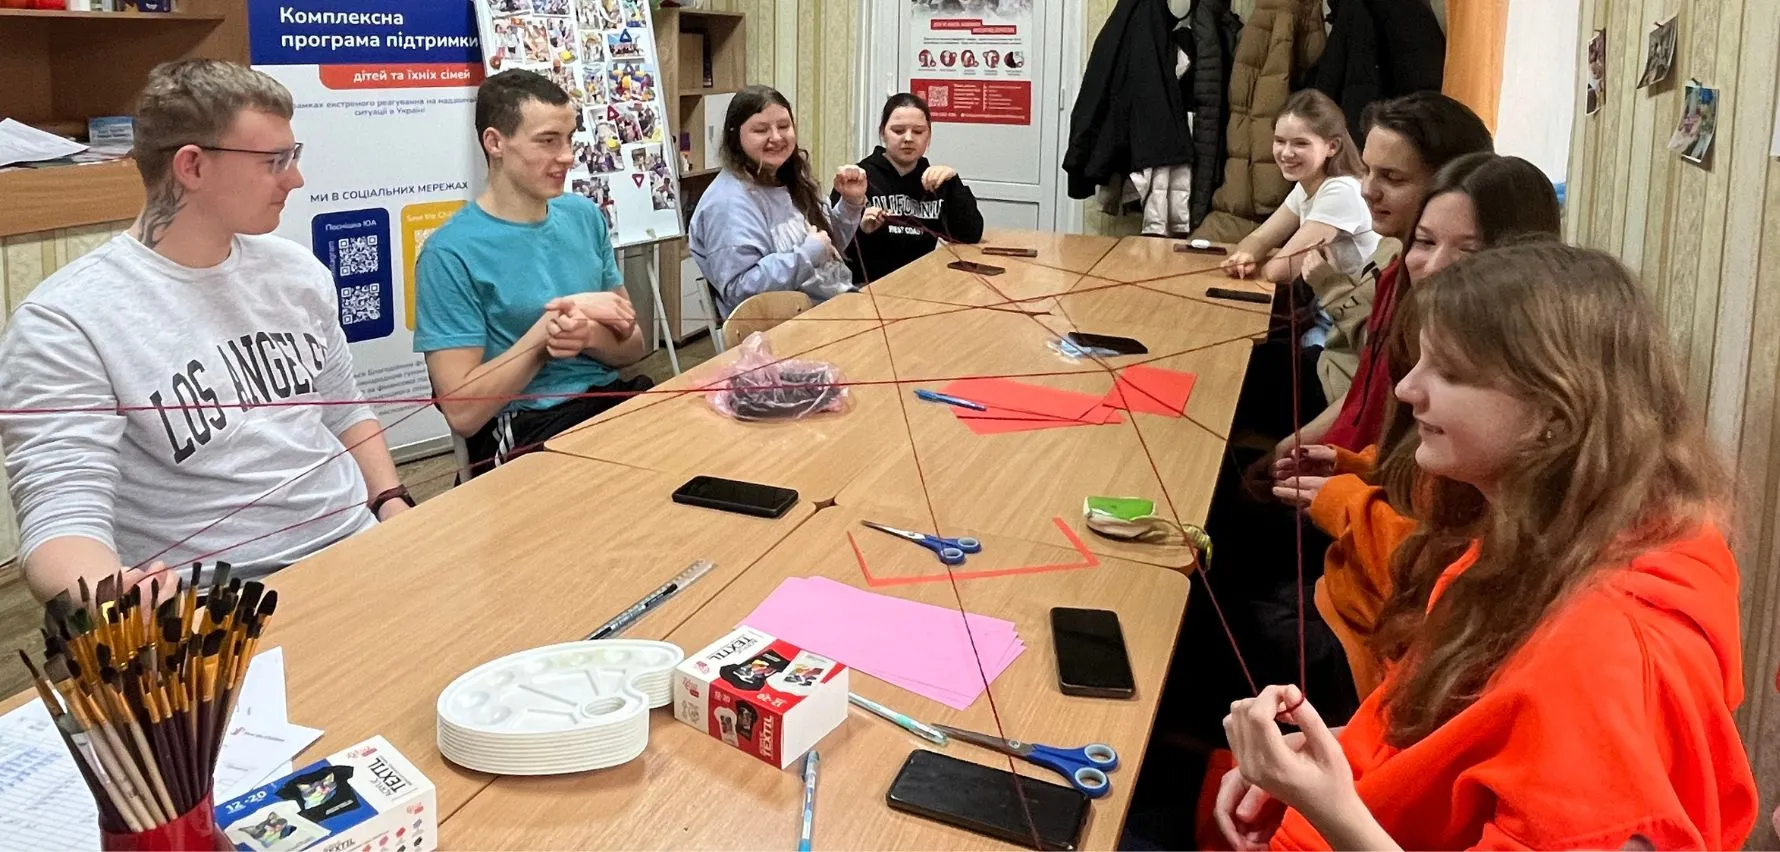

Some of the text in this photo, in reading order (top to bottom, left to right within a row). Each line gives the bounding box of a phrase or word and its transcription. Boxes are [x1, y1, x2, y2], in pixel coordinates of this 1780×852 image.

[280, 6, 404, 25] Комплексна
[281, 31, 479, 50] програма підтримки
[353, 68, 471, 83] дітей та їхніх сімей
[310, 181, 468, 203] МИ В СОЦІАЛЬНИХ МЕРЕЖАХ
[868, 194, 944, 220] ALIFORNI
[888, 225, 903, 234] WEST
[149, 359, 227, 464] LOS
[709, 636, 752, 660] TEXTIL
[763, 715, 773, 757] TEXTIL
[368, 757, 406, 794] TEXTIL
